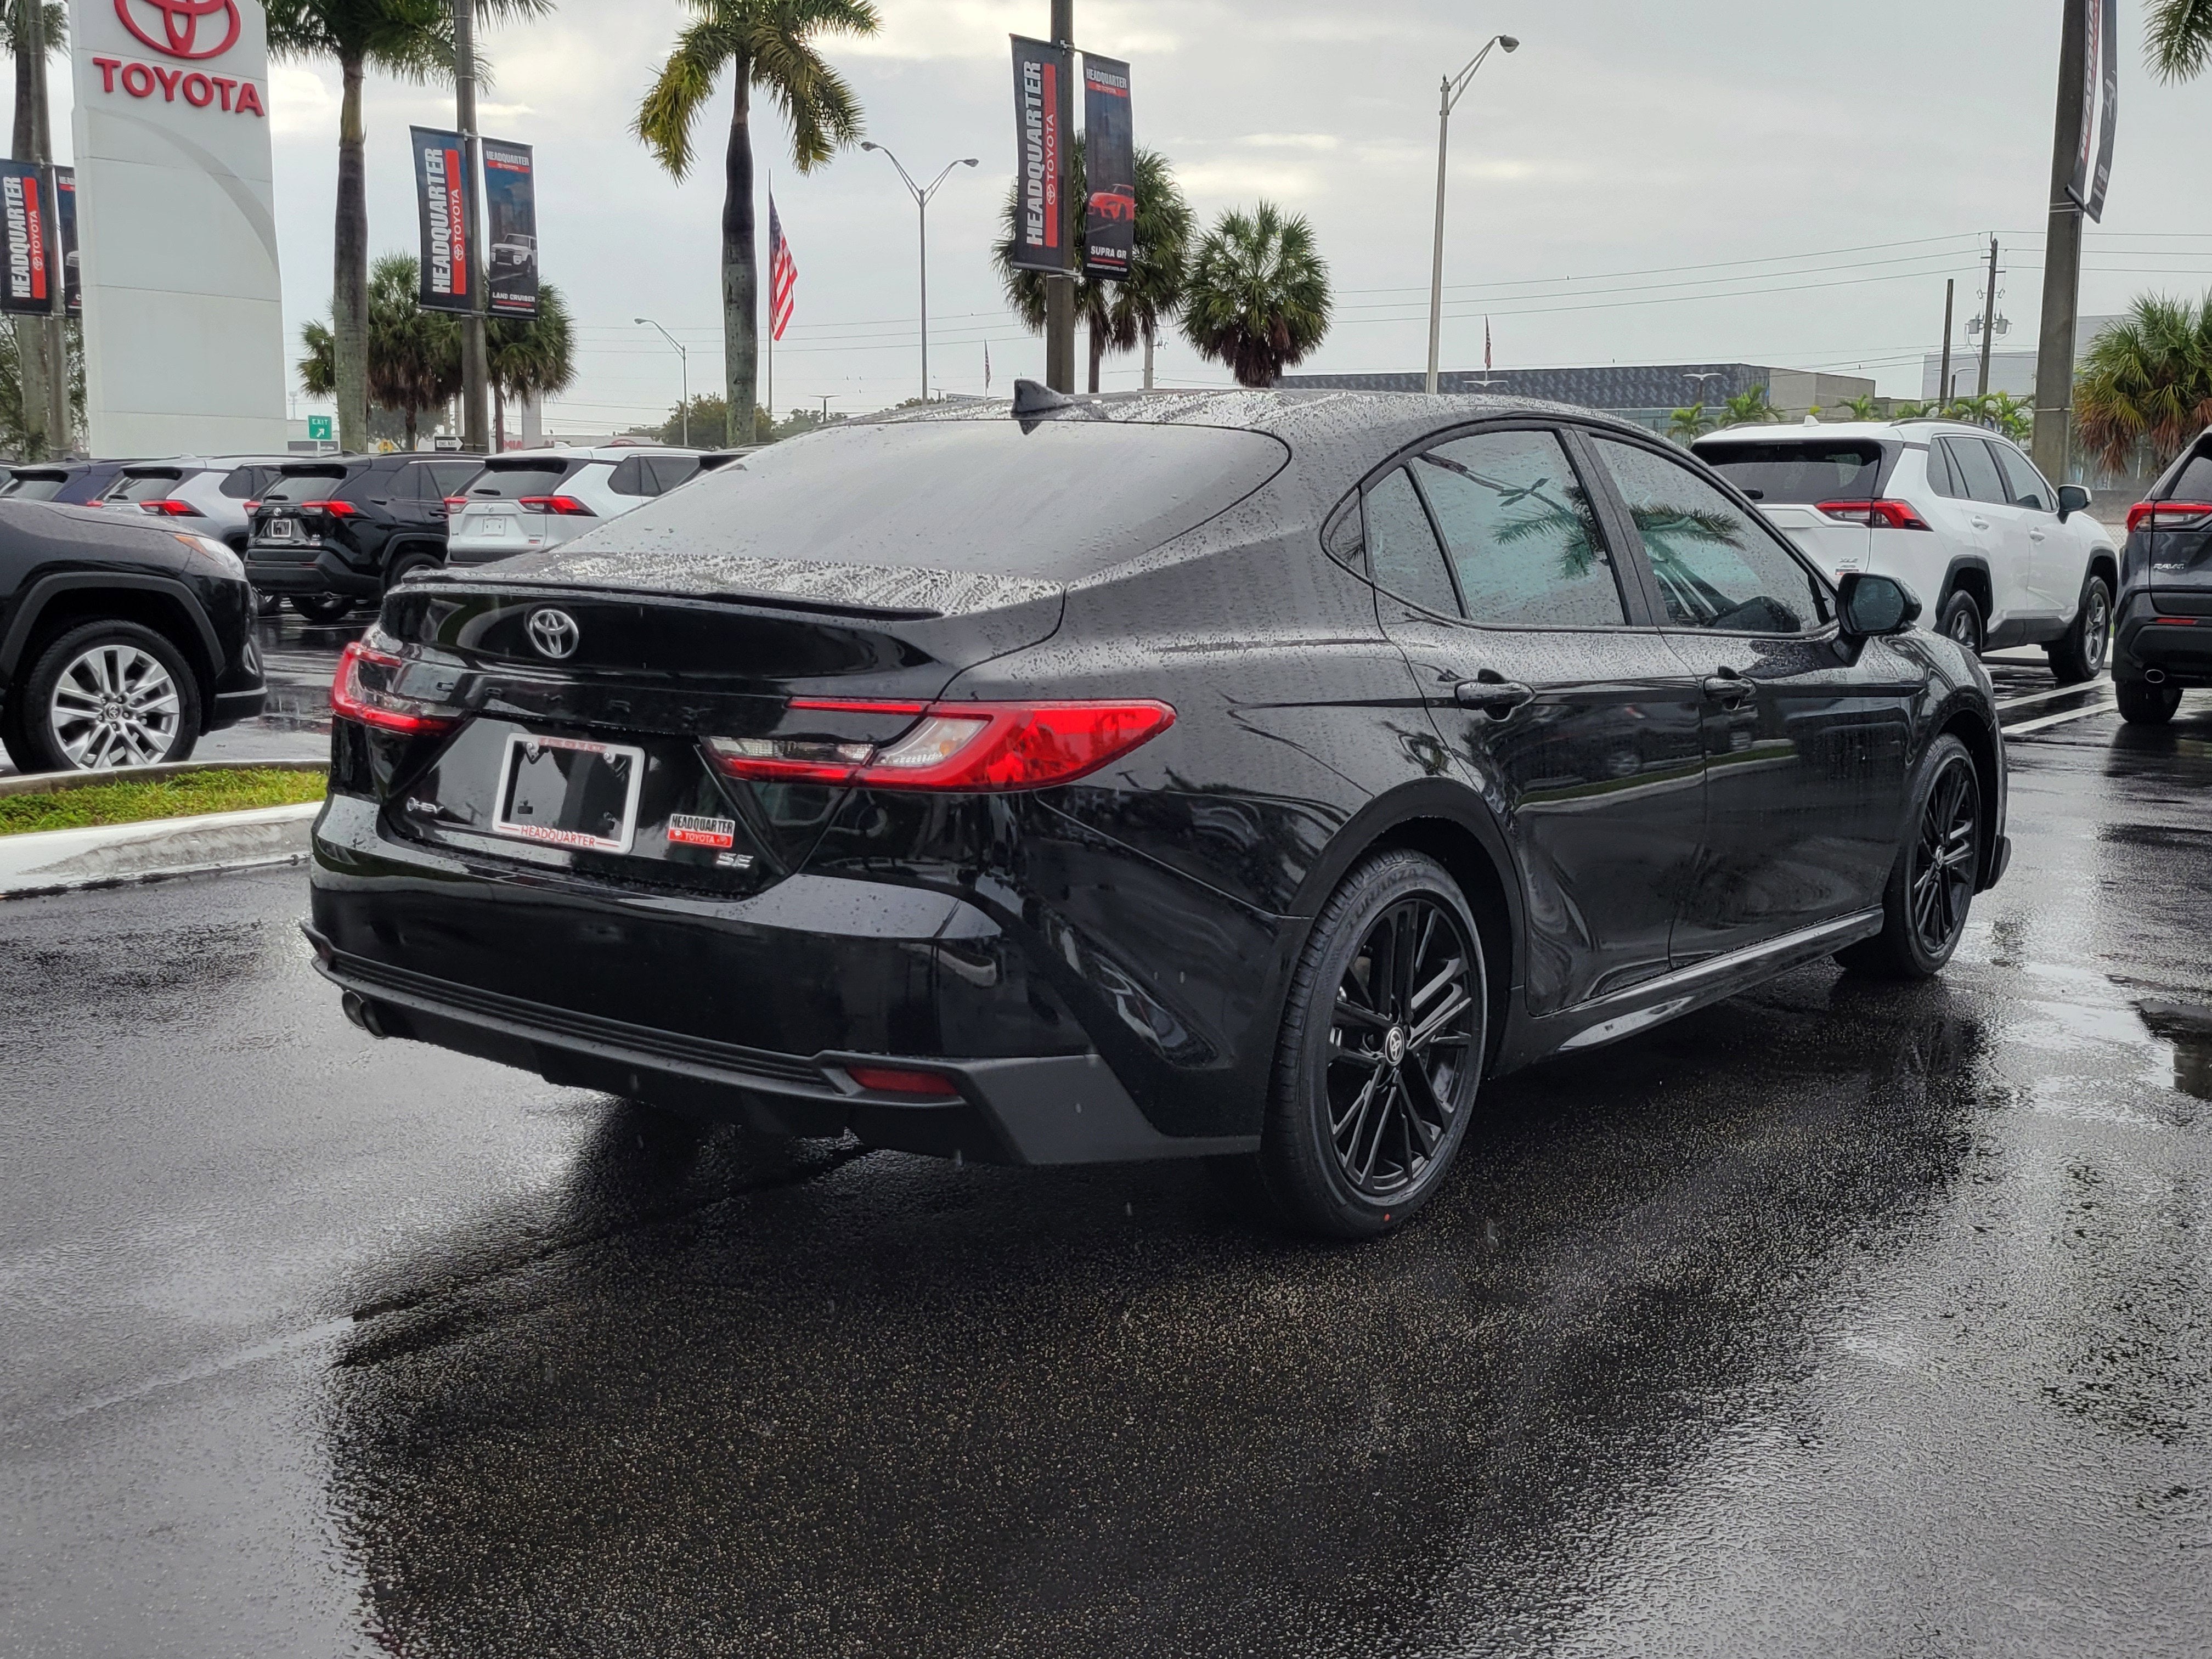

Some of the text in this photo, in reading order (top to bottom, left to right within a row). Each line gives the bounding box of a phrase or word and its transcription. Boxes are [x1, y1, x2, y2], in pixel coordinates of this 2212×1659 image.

[92, 57, 266, 117] TOYOTA
[1086, 67, 1127, 89] HEADQUARTER
[486, 150, 530, 166] HEADQUARTER
[1023, 60, 1043, 246] HEADQUARTER
[1046, 114, 1056, 182] TOYOTA
[424, 147, 452, 294] HEADQUARTER
[450, 189, 462, 242] TOYOTA
[3, 176, 31, 298] HEADQUARTER
[30, 210, 42, 255] TOYOTA
[1090, 245, 1127, 259] SUPRA GR
[492, 291, 536, 303] LAND CRUISER
[521, 824, 596, 847] HEADQUARTER
[670, 815, 733, 835] HEADQUARTER
[685, 832, 715, 844] TOYOTA
[716, 851, 754, 869] SE
